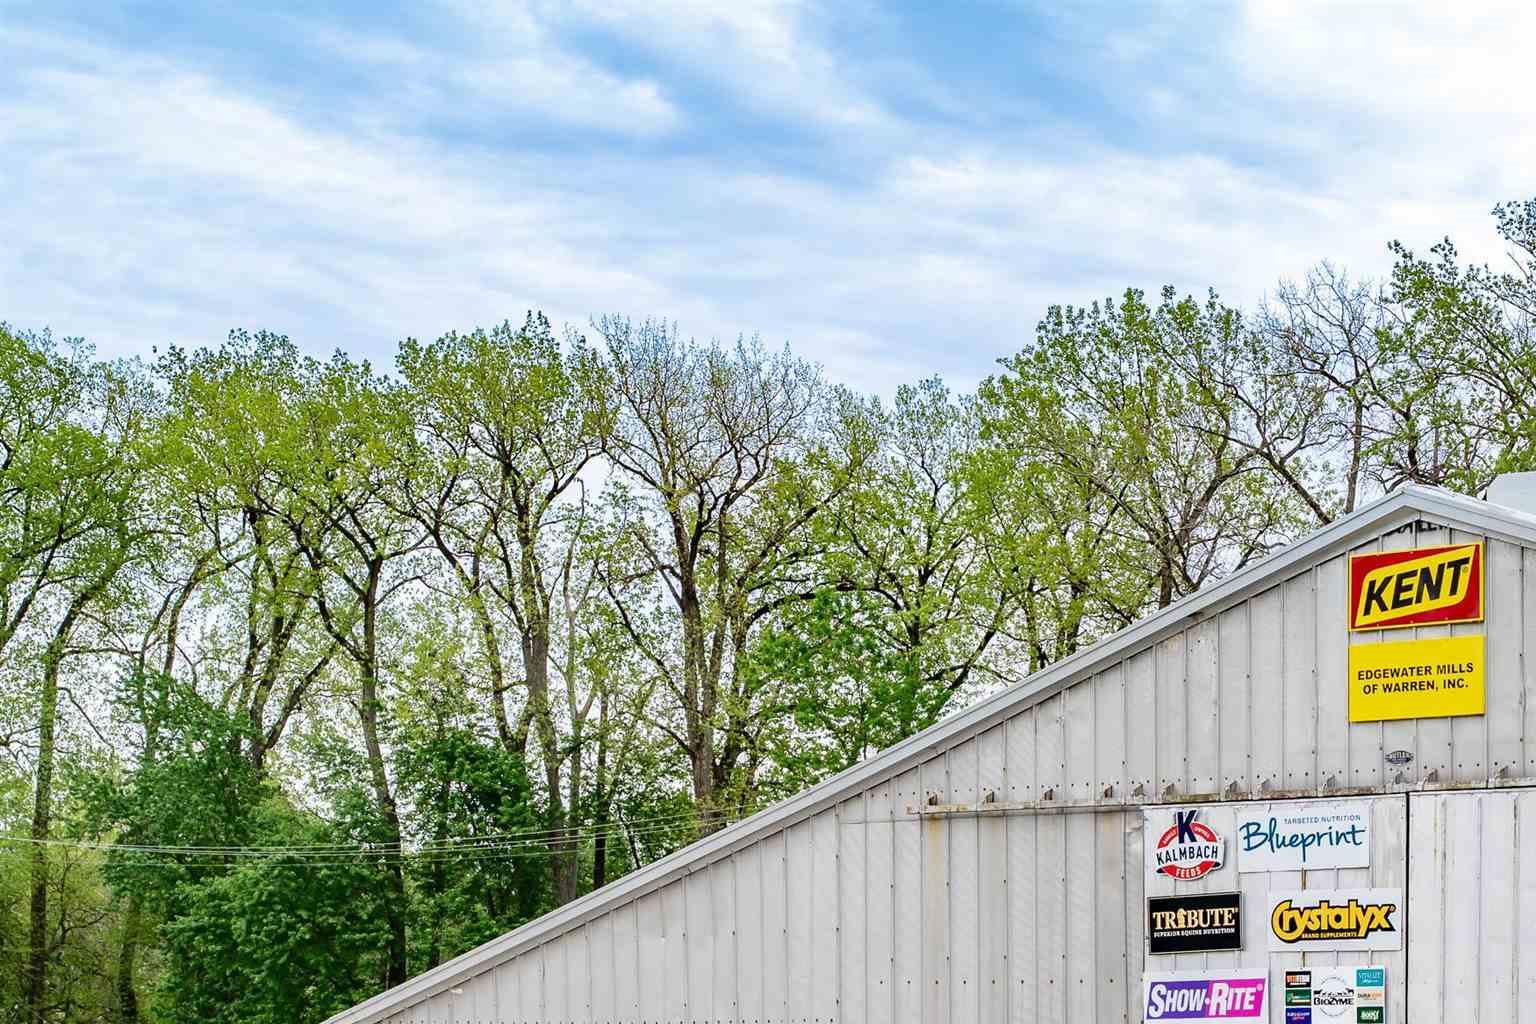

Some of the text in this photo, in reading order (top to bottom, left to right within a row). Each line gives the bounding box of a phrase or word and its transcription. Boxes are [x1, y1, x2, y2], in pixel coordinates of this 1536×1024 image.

[1362, 556, 1471, 617] KENT
[1357, 662, 1474, 681] EDGEWATER MILLS
[1363, 678, 1469, 695] OF WARREN, INC.
[1177, 809, 1198, 844] K
[1321, 814, 1361, 823] NUTRITION
[1239, 817, 1366, 863] Blueprint
[1156, 845, 1219, 866] KALMBACH
[1175, 866, 1202, 878] FEEDS
[1152, 907, 1236, 930] TRIBUTE
[1271, 899, 1393, 943] Crystalyx
